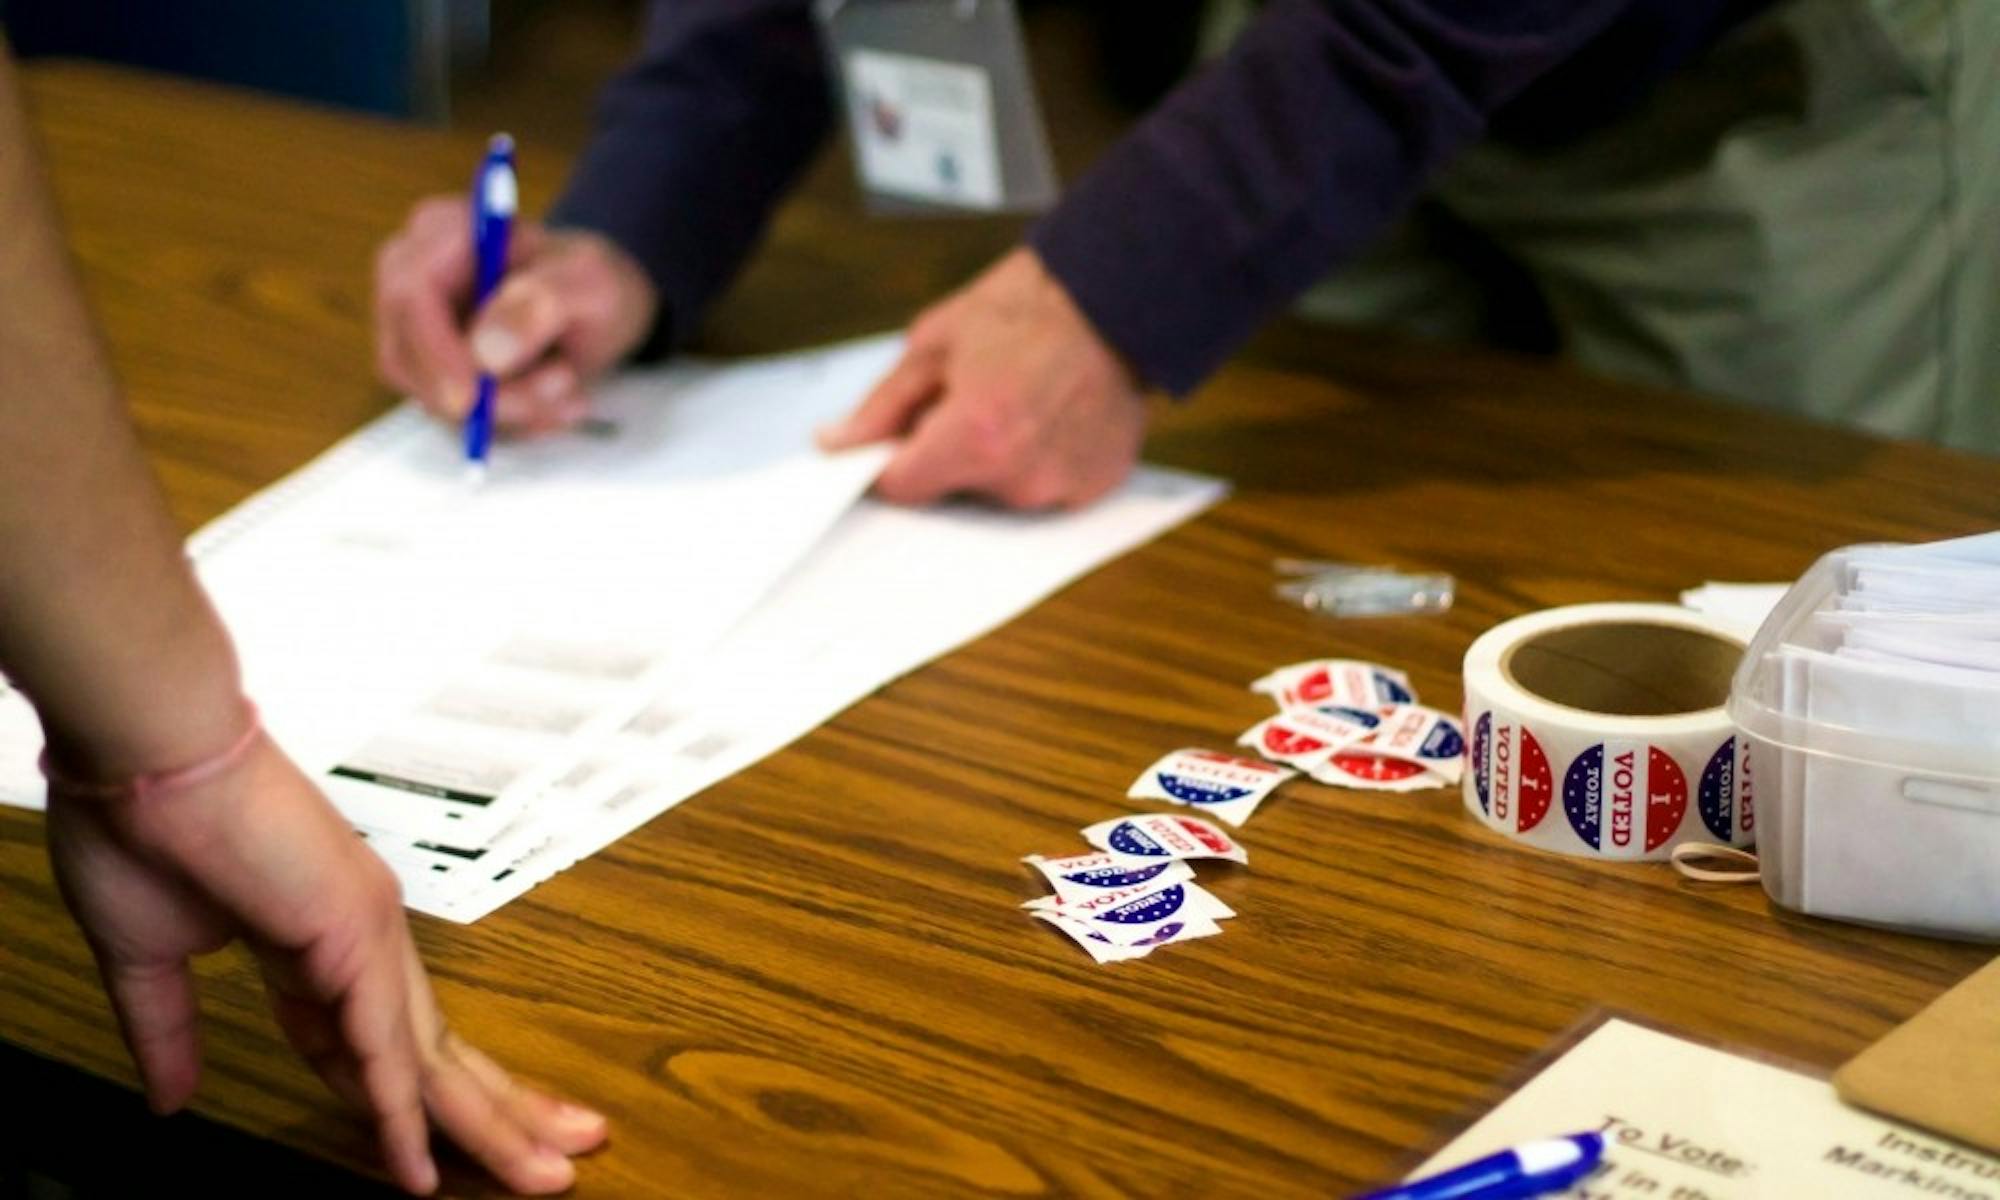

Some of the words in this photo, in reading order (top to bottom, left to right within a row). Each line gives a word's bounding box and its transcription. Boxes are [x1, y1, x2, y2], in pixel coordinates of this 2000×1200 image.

[1495, 725, 1511, 820] VOTED
[1522, 776, 1539, 790] I
[1719, 761, 1732, 817] TODAY
[1585, 766, 1600, 825] TODAY
[1612, 751, 1634, 846] VOTED
[1651, 793, 1671, 805] I
[1115, 892, 1167, 917] TODAY
[1600, 1114, 1643, 1144] To
